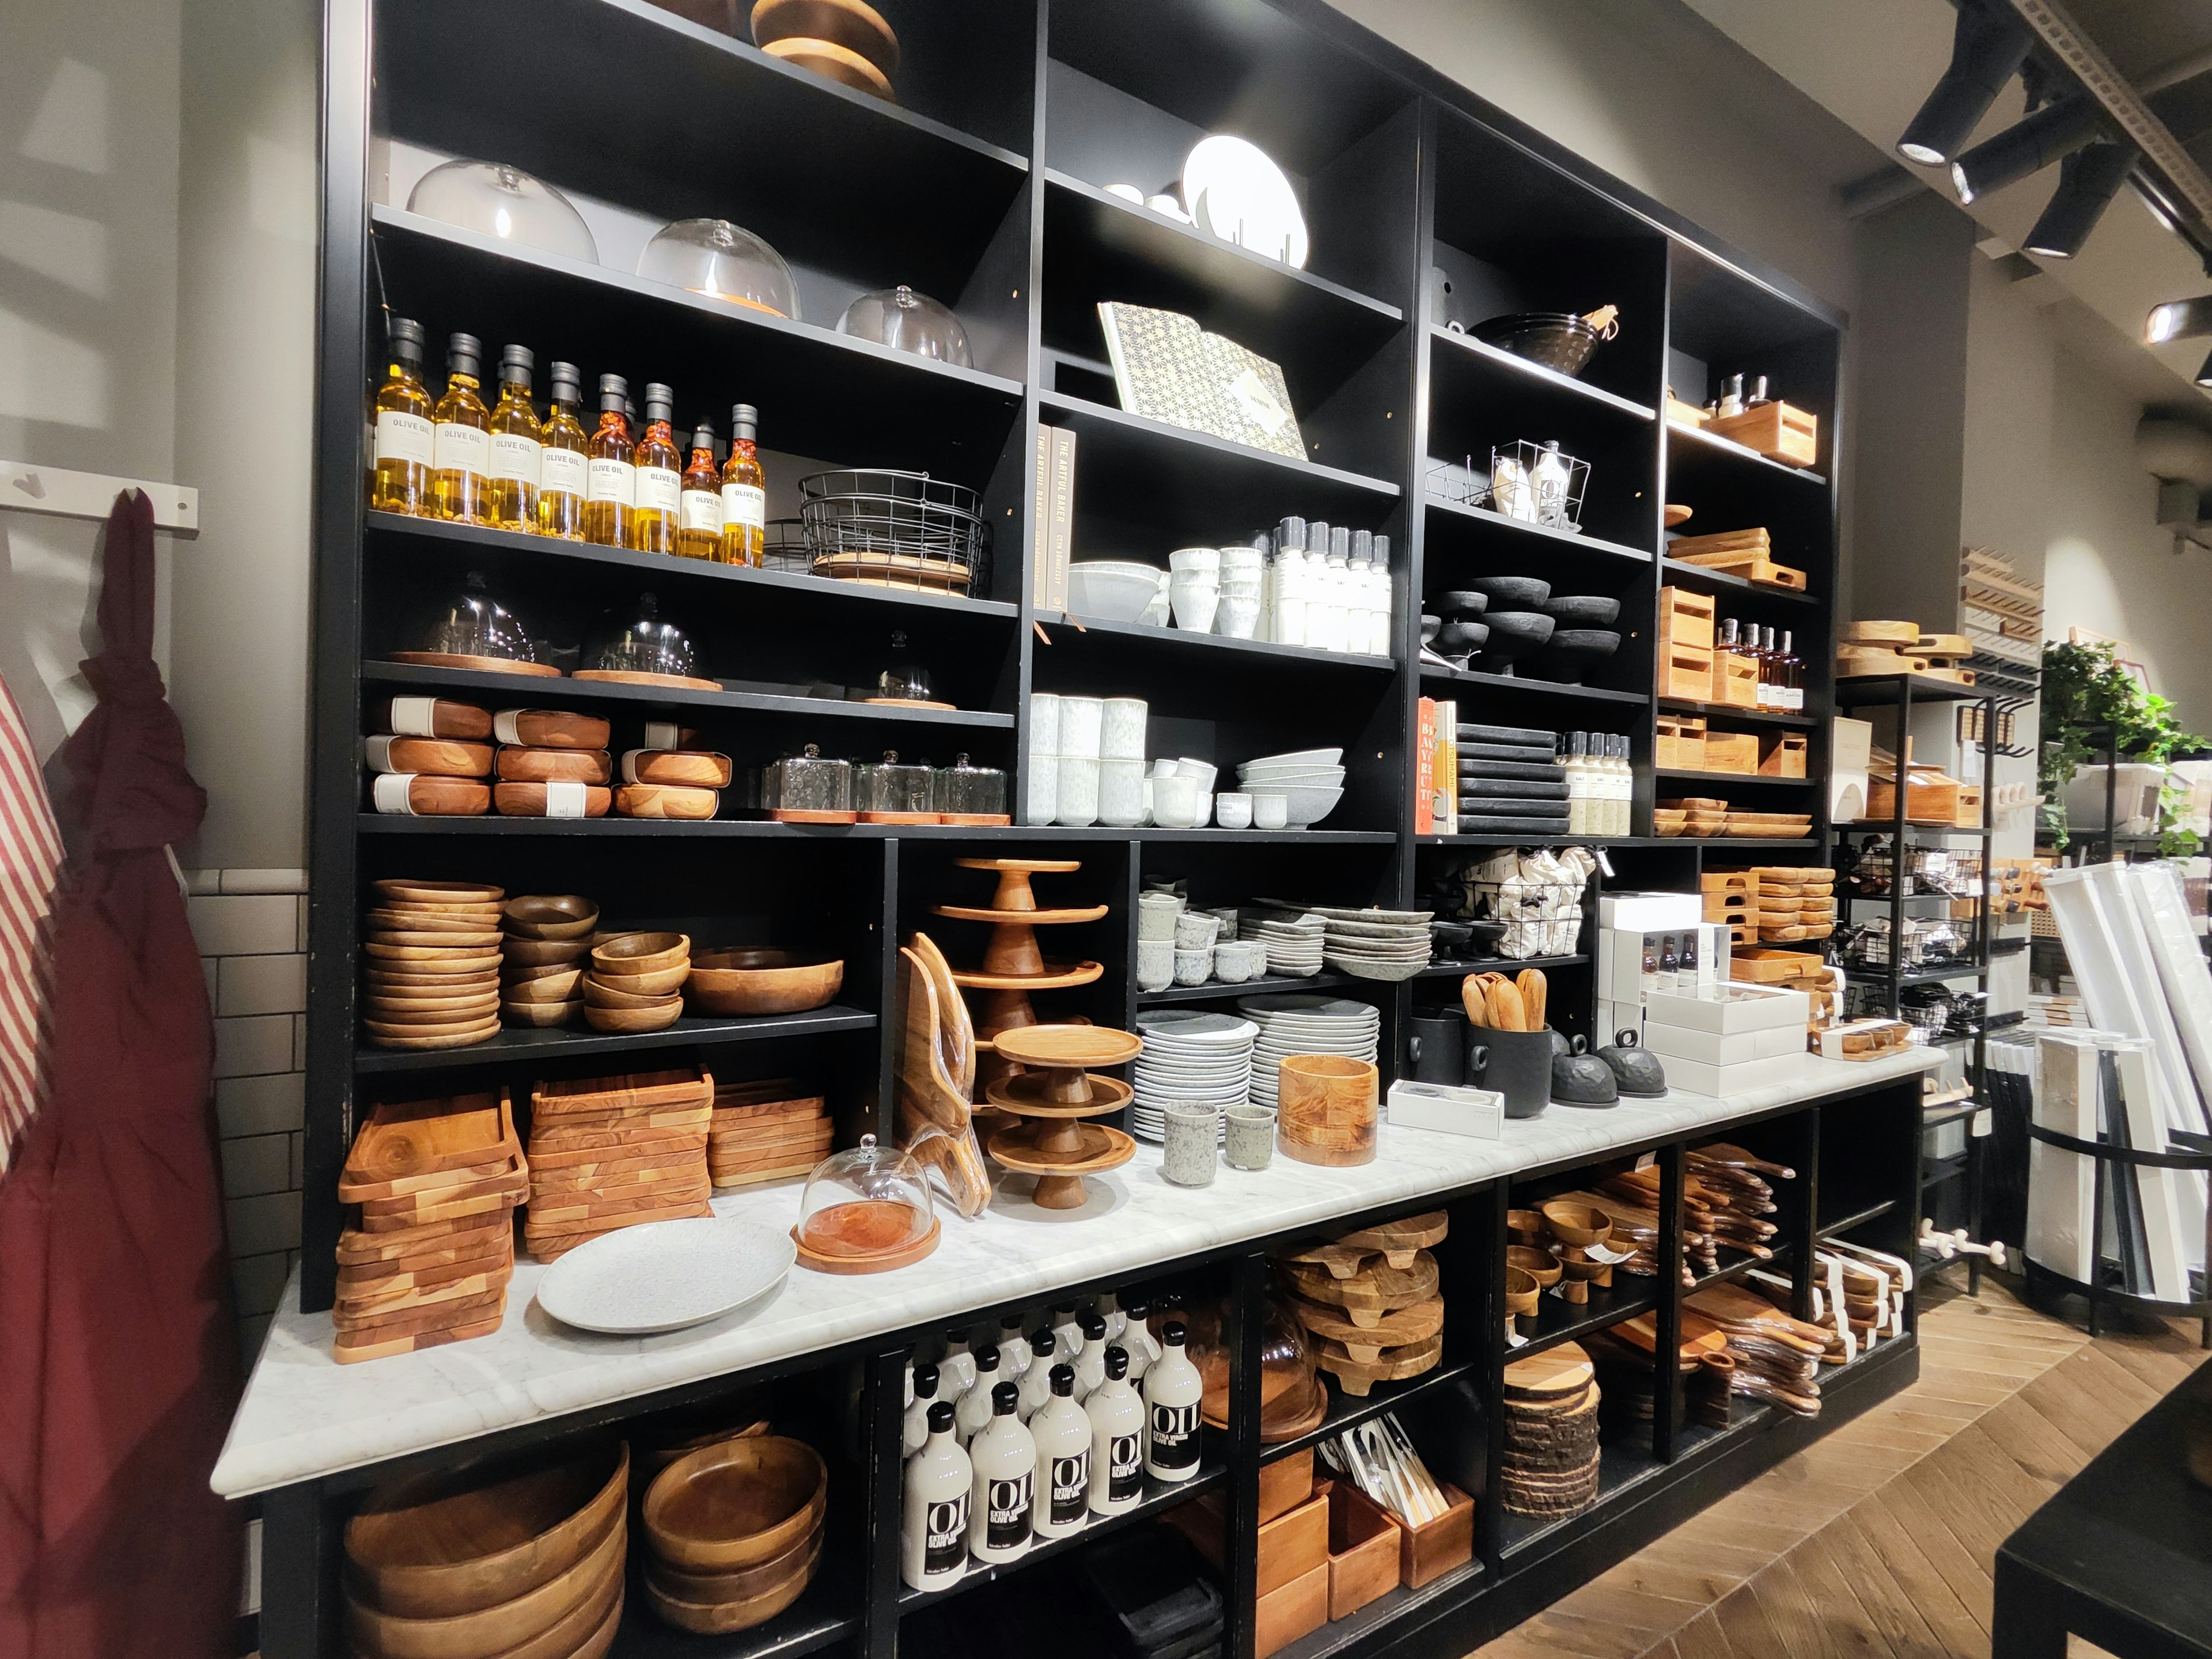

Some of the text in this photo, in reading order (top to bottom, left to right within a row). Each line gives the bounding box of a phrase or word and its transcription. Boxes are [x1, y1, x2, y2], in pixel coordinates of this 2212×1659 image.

[393, 419, 418, 430] OLIVE
[419, 425, 430, 435] OIL
[445, 430, 467, 440] OLIVE
[469, 434, 481, 443] OIL
[496, 441, 517, 449] OLIVE
[519, 443, 531, 452] OIL
[546, 454, 580, 466] OLIVE OIL
[612, 466, 623, 475] OIL
[650, 473, 671, 482] OLIVE
[1056, 441, 1069, 523] THE ARTFUL BAKER
[735, 490, 753, 498] OLIVE
[696, 497, 714, 505] OLIVE
[1153, 1430, 1169, 1440] EXTRA
[1153, 1437, 1167, 1445] OLIVE
[1112, 1464, 1130, 1473] EXTRA
[1054, 1487, 1073, 1495] EXTRA
[1008, 1514, 1018, 1522] OIL
[929, 1533, 950, 1543] EXTRA
[928, 1540, 947, 1548] OLIVE
